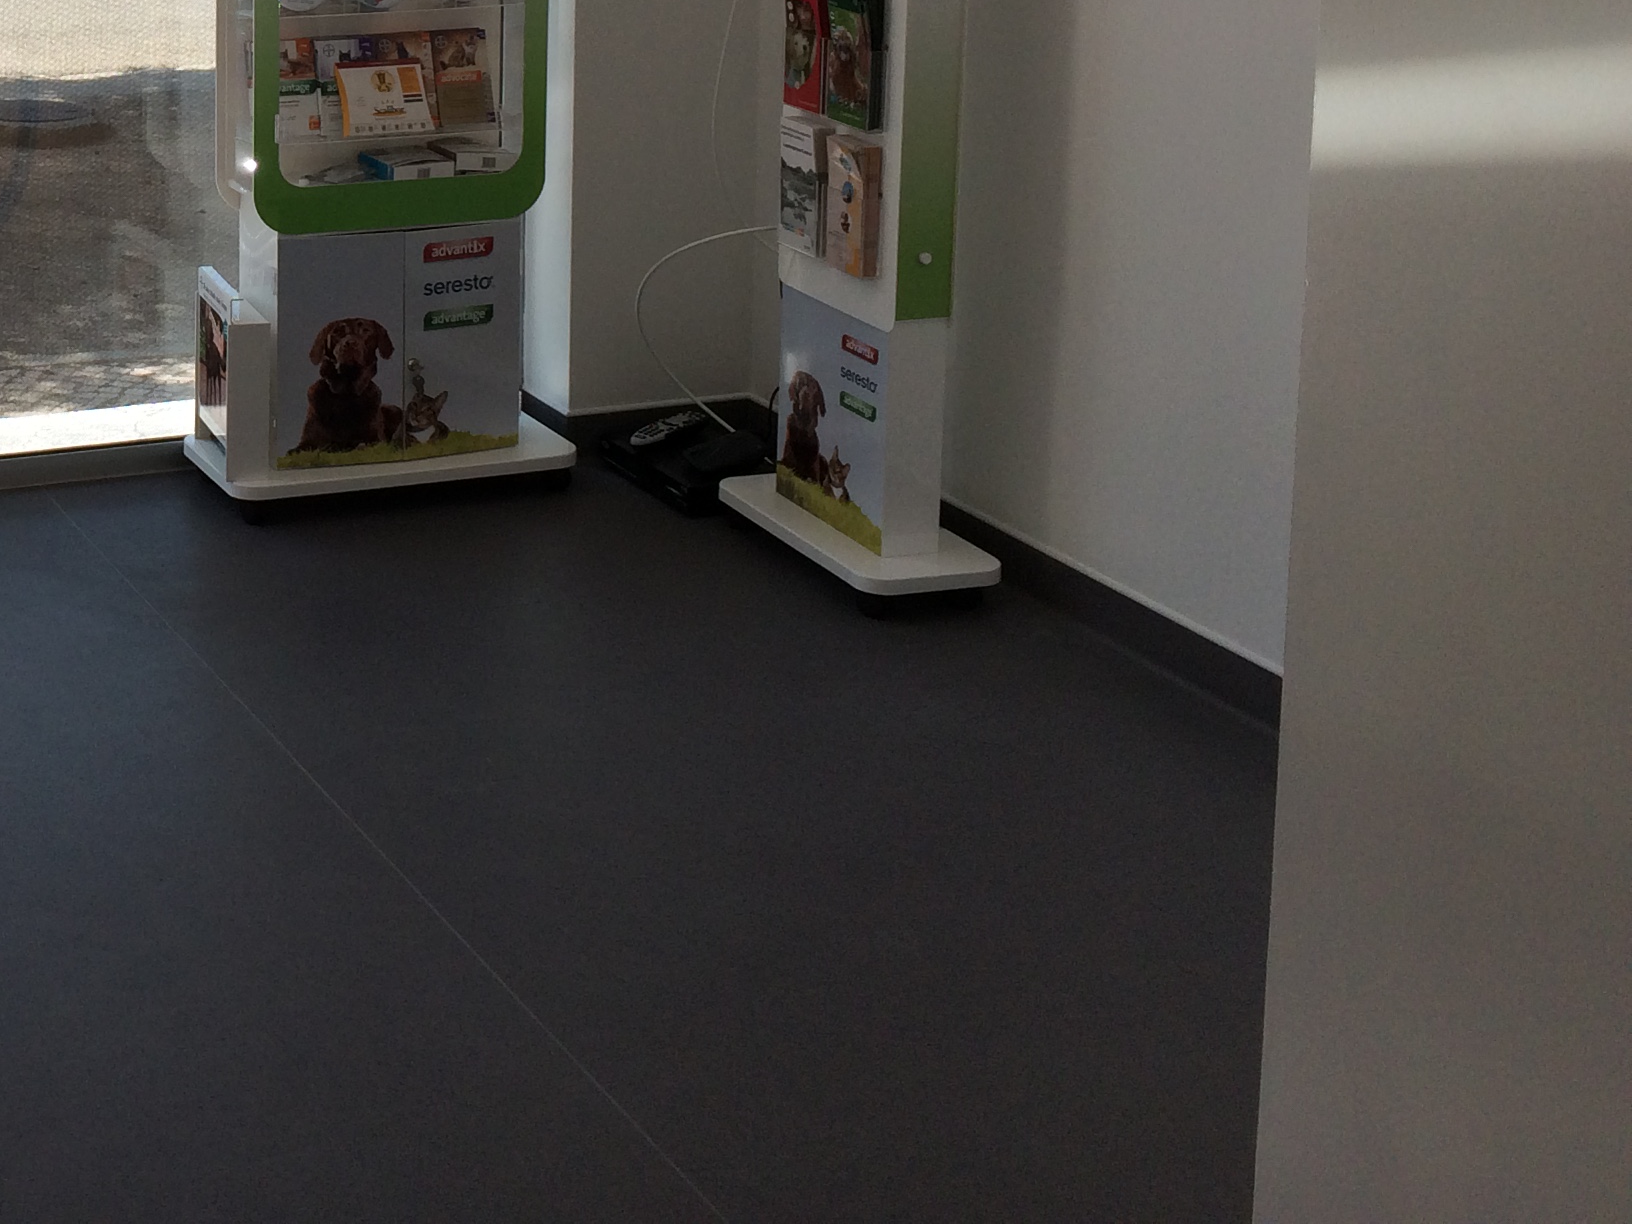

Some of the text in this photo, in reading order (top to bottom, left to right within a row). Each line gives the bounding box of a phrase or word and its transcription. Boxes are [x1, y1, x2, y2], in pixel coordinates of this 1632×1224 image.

[431, 240, 486, 257] advantix
[423, 275, 494, 296] seresto
[431, 309, 486, 325] advantage
